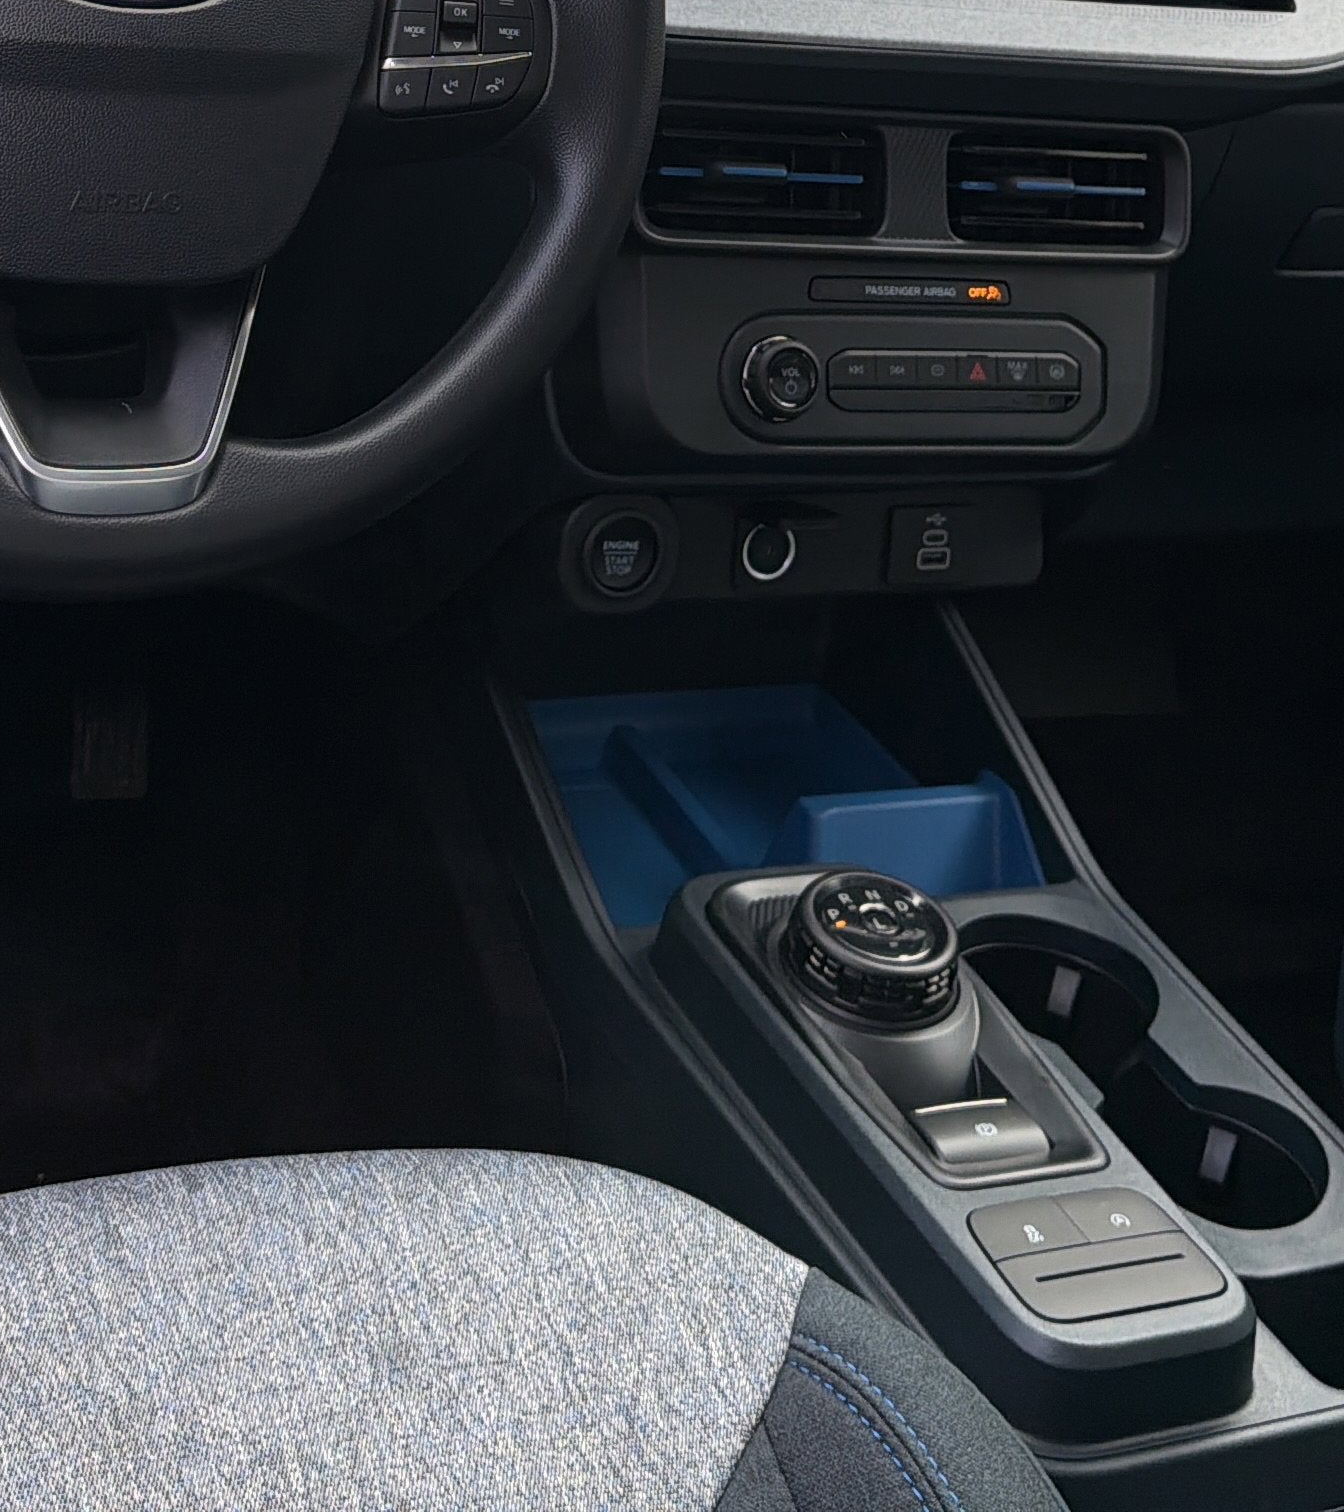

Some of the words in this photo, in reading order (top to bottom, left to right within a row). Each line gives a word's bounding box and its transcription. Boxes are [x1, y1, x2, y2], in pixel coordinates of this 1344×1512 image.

[454, 6, 468, 18] OK
[403, 25, 426, 35] MODE
[499, 26, 520, 37] MODE
[70, 190, 184, 216] AIRBAG
[865, 285, 921, 297] PASSENGER
[923, 287, 956, 298] AIRBAG
[968, 287, 988, 298] OFF
[781, 367, 801, 377] VOL
[602, 540, 641, 551] ENGINE
[605, 555, 635, 565] START
[606, 564, 633, 576] STOP
[837, 892, 853, 905] R
[864, 889, 881, 901] N
[894, 900, 909, 913] D
[826, 908, 840, 921] P
